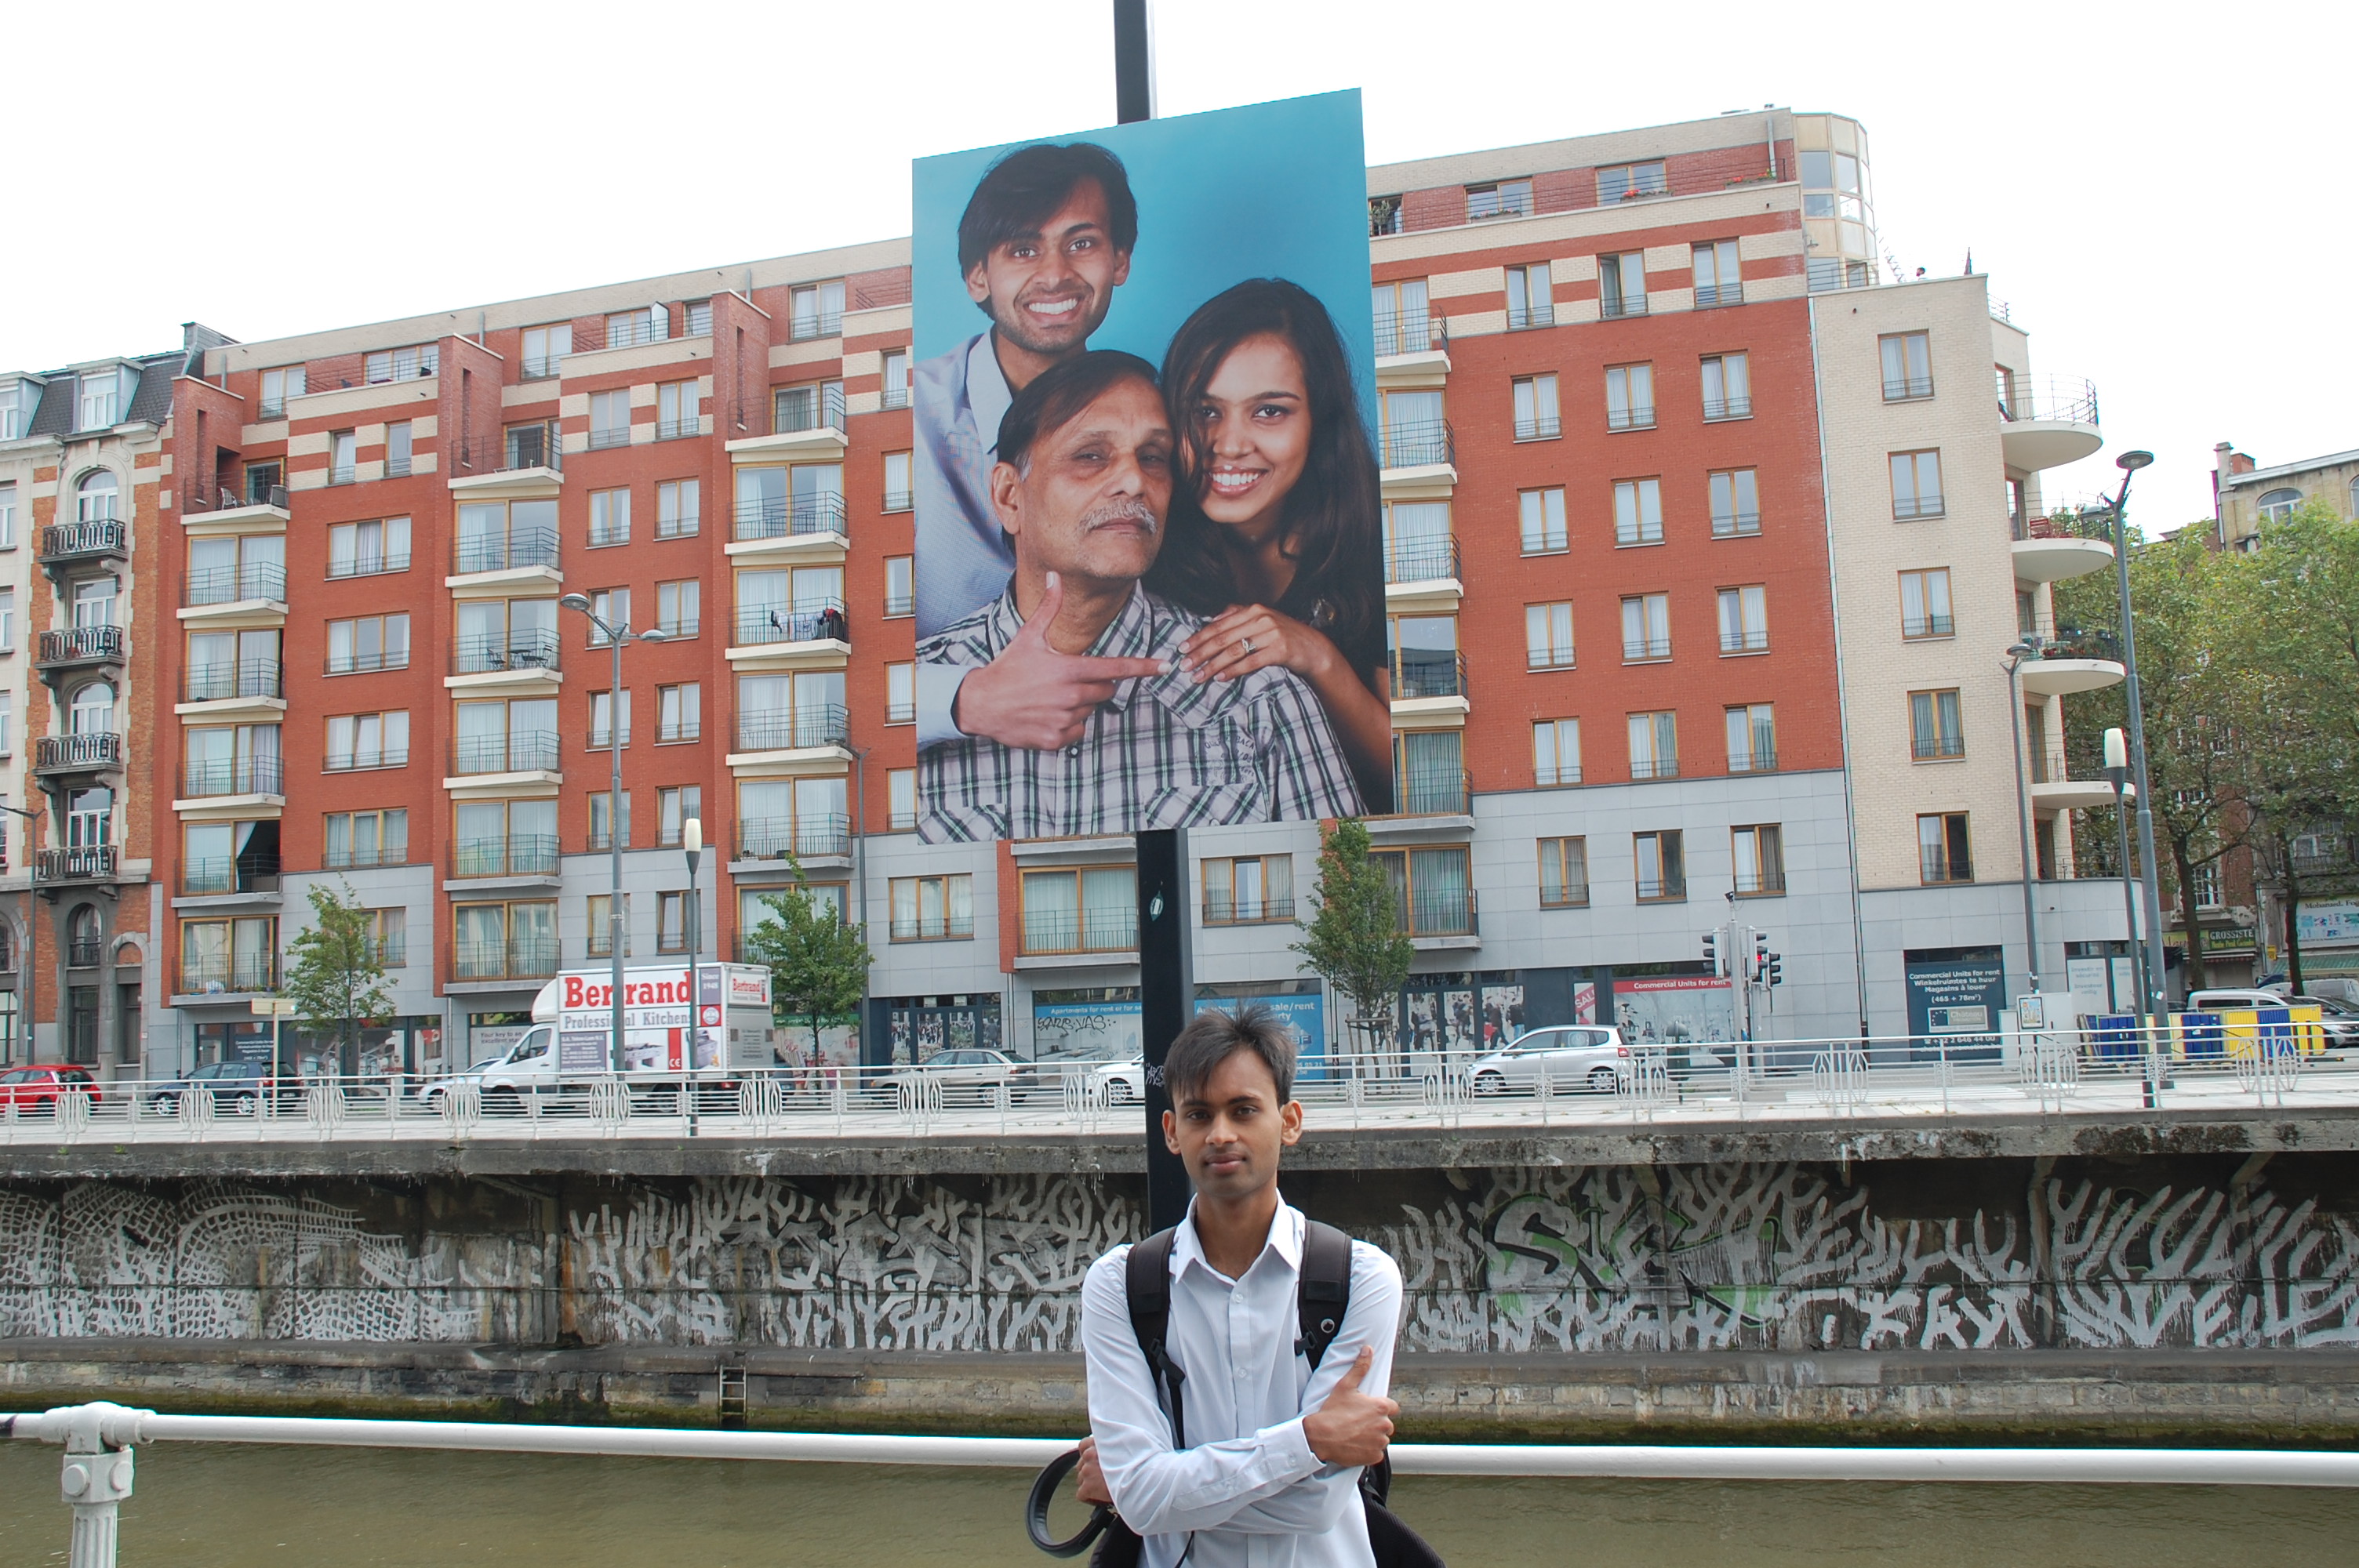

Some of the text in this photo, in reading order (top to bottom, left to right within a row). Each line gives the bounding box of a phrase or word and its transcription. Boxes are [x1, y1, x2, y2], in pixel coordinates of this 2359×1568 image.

[2210, 929, 2254, 940] GROSSISTE
[565, 971, 690, 1007] Berrand
[1270, 1002, 1315, 1011] sale/rent
[565, 1012, 635, 1029] Professial
